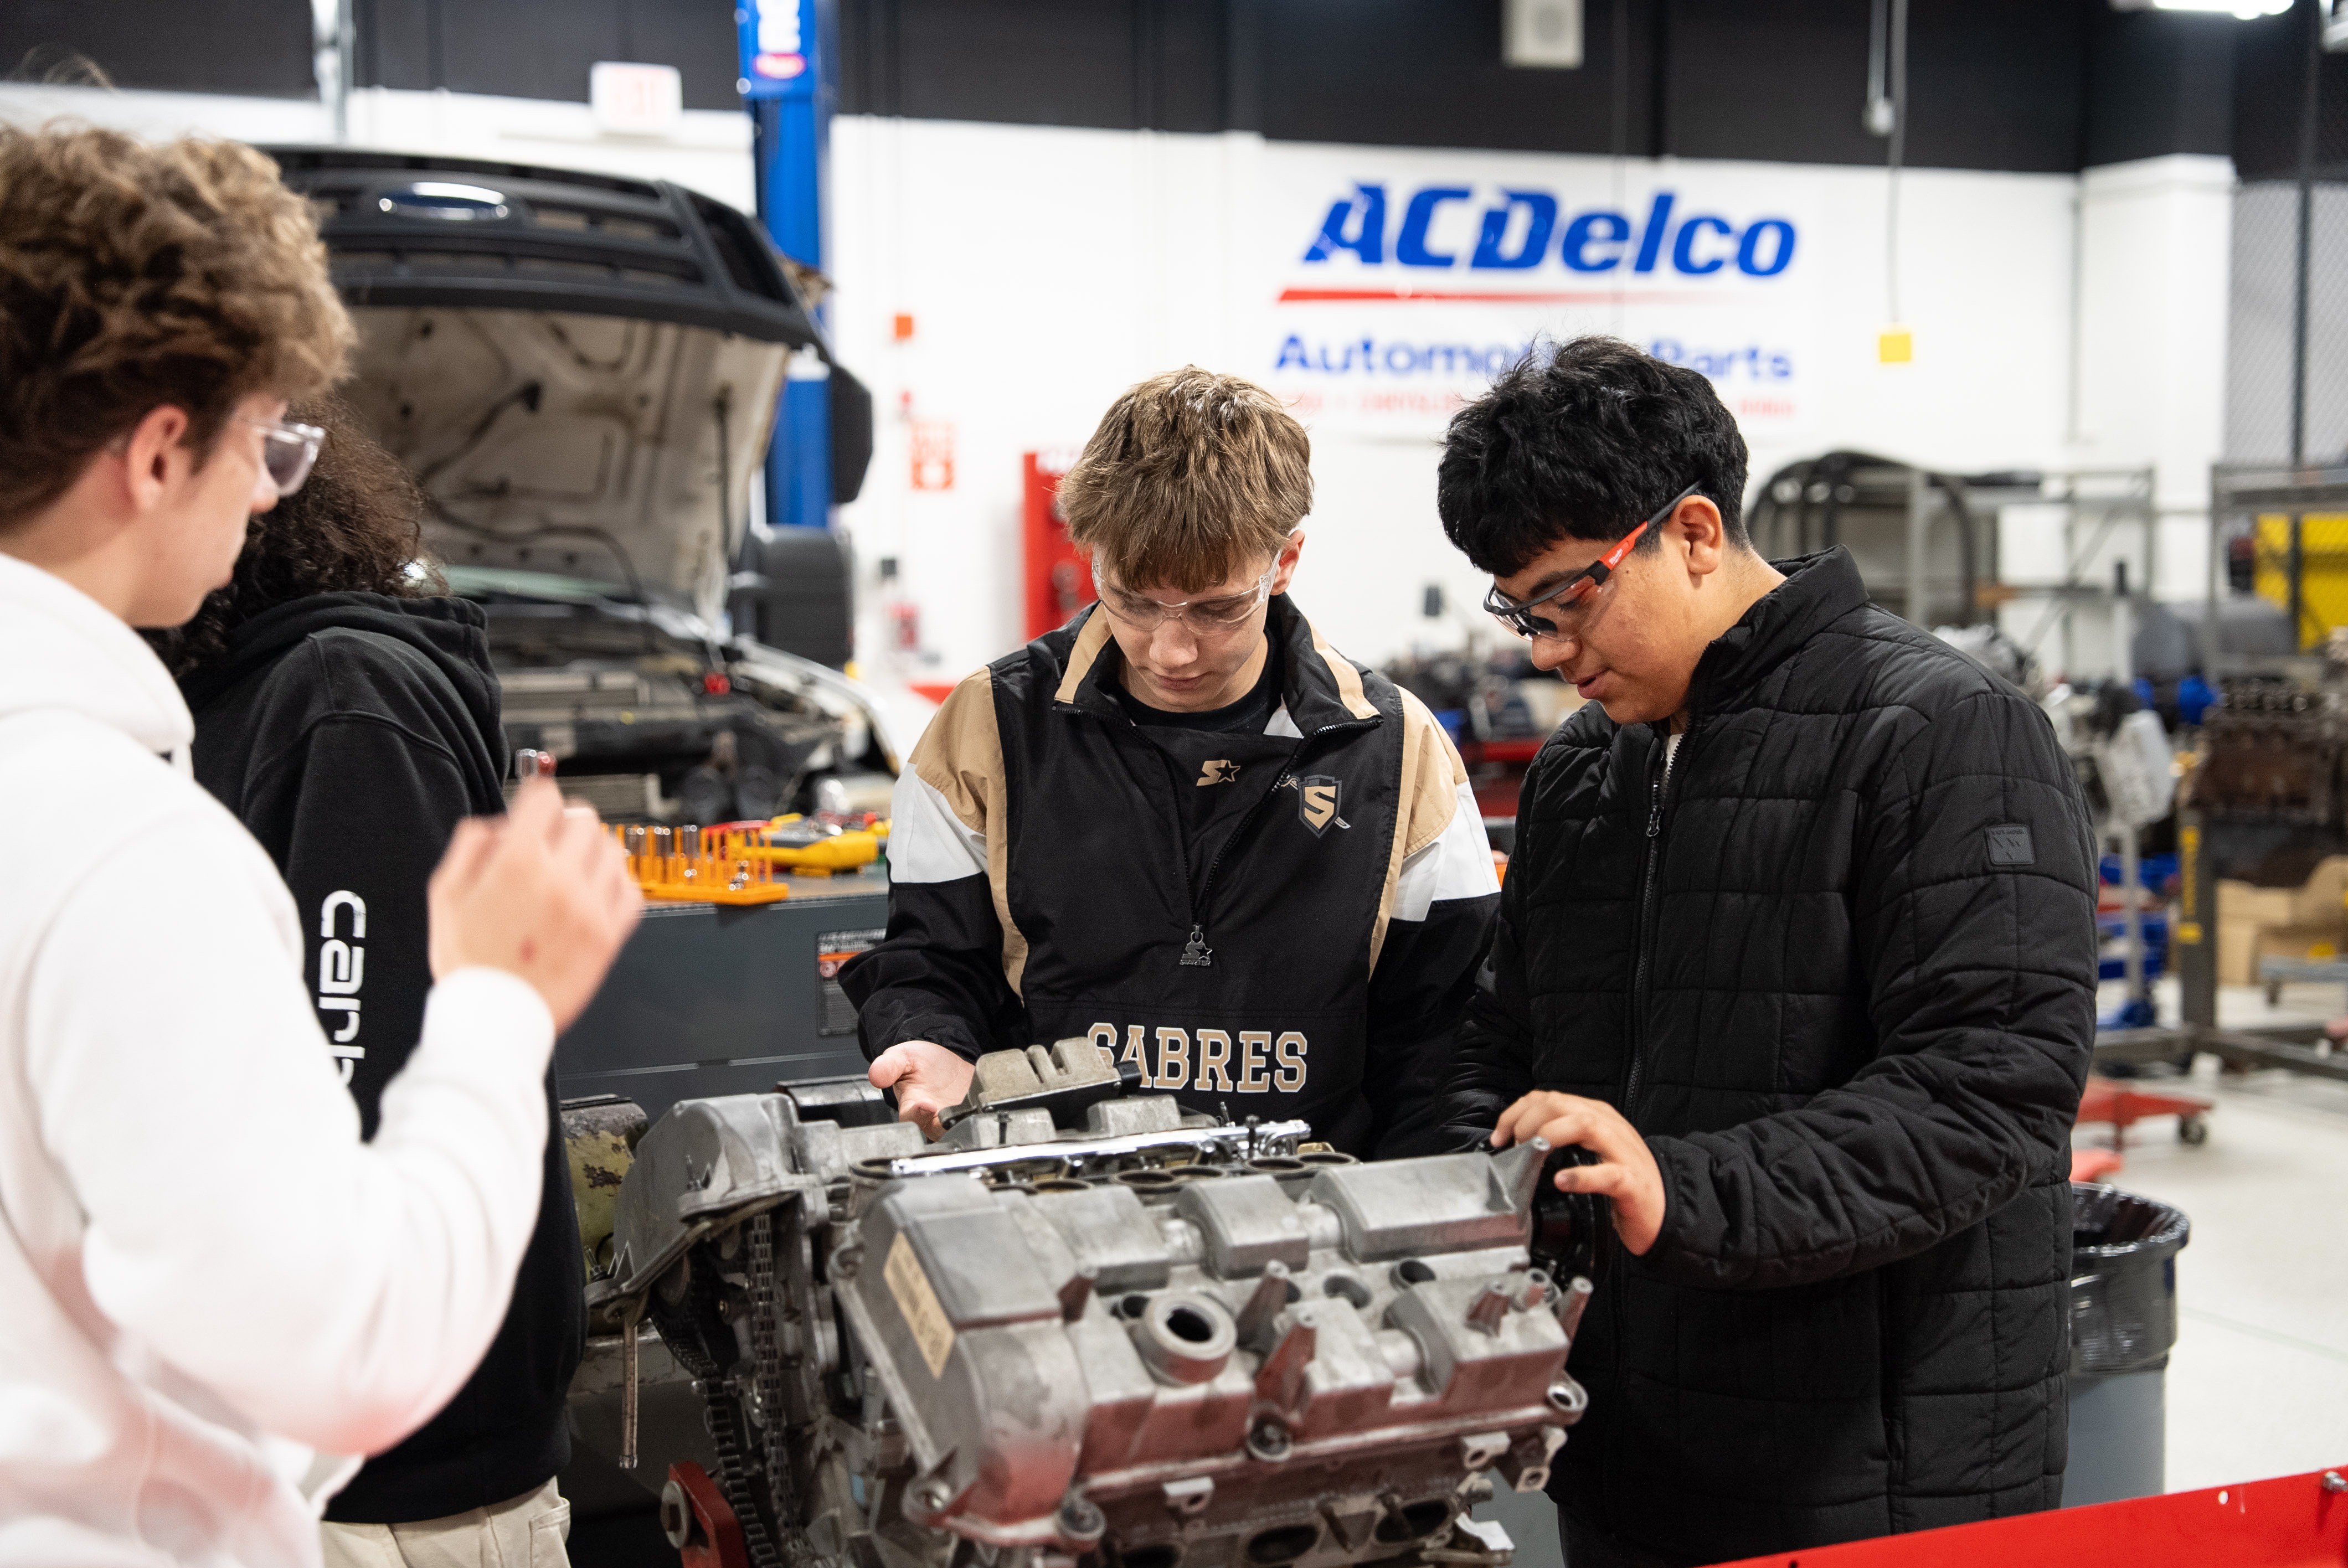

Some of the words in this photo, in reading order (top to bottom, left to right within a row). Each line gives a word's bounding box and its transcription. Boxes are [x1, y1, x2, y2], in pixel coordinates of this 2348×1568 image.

[1304, 183, 1797, 276] ACDelco
[318, 890, 367, 1087] carh
[1088, 1022, 1308, 1092] SABRES
